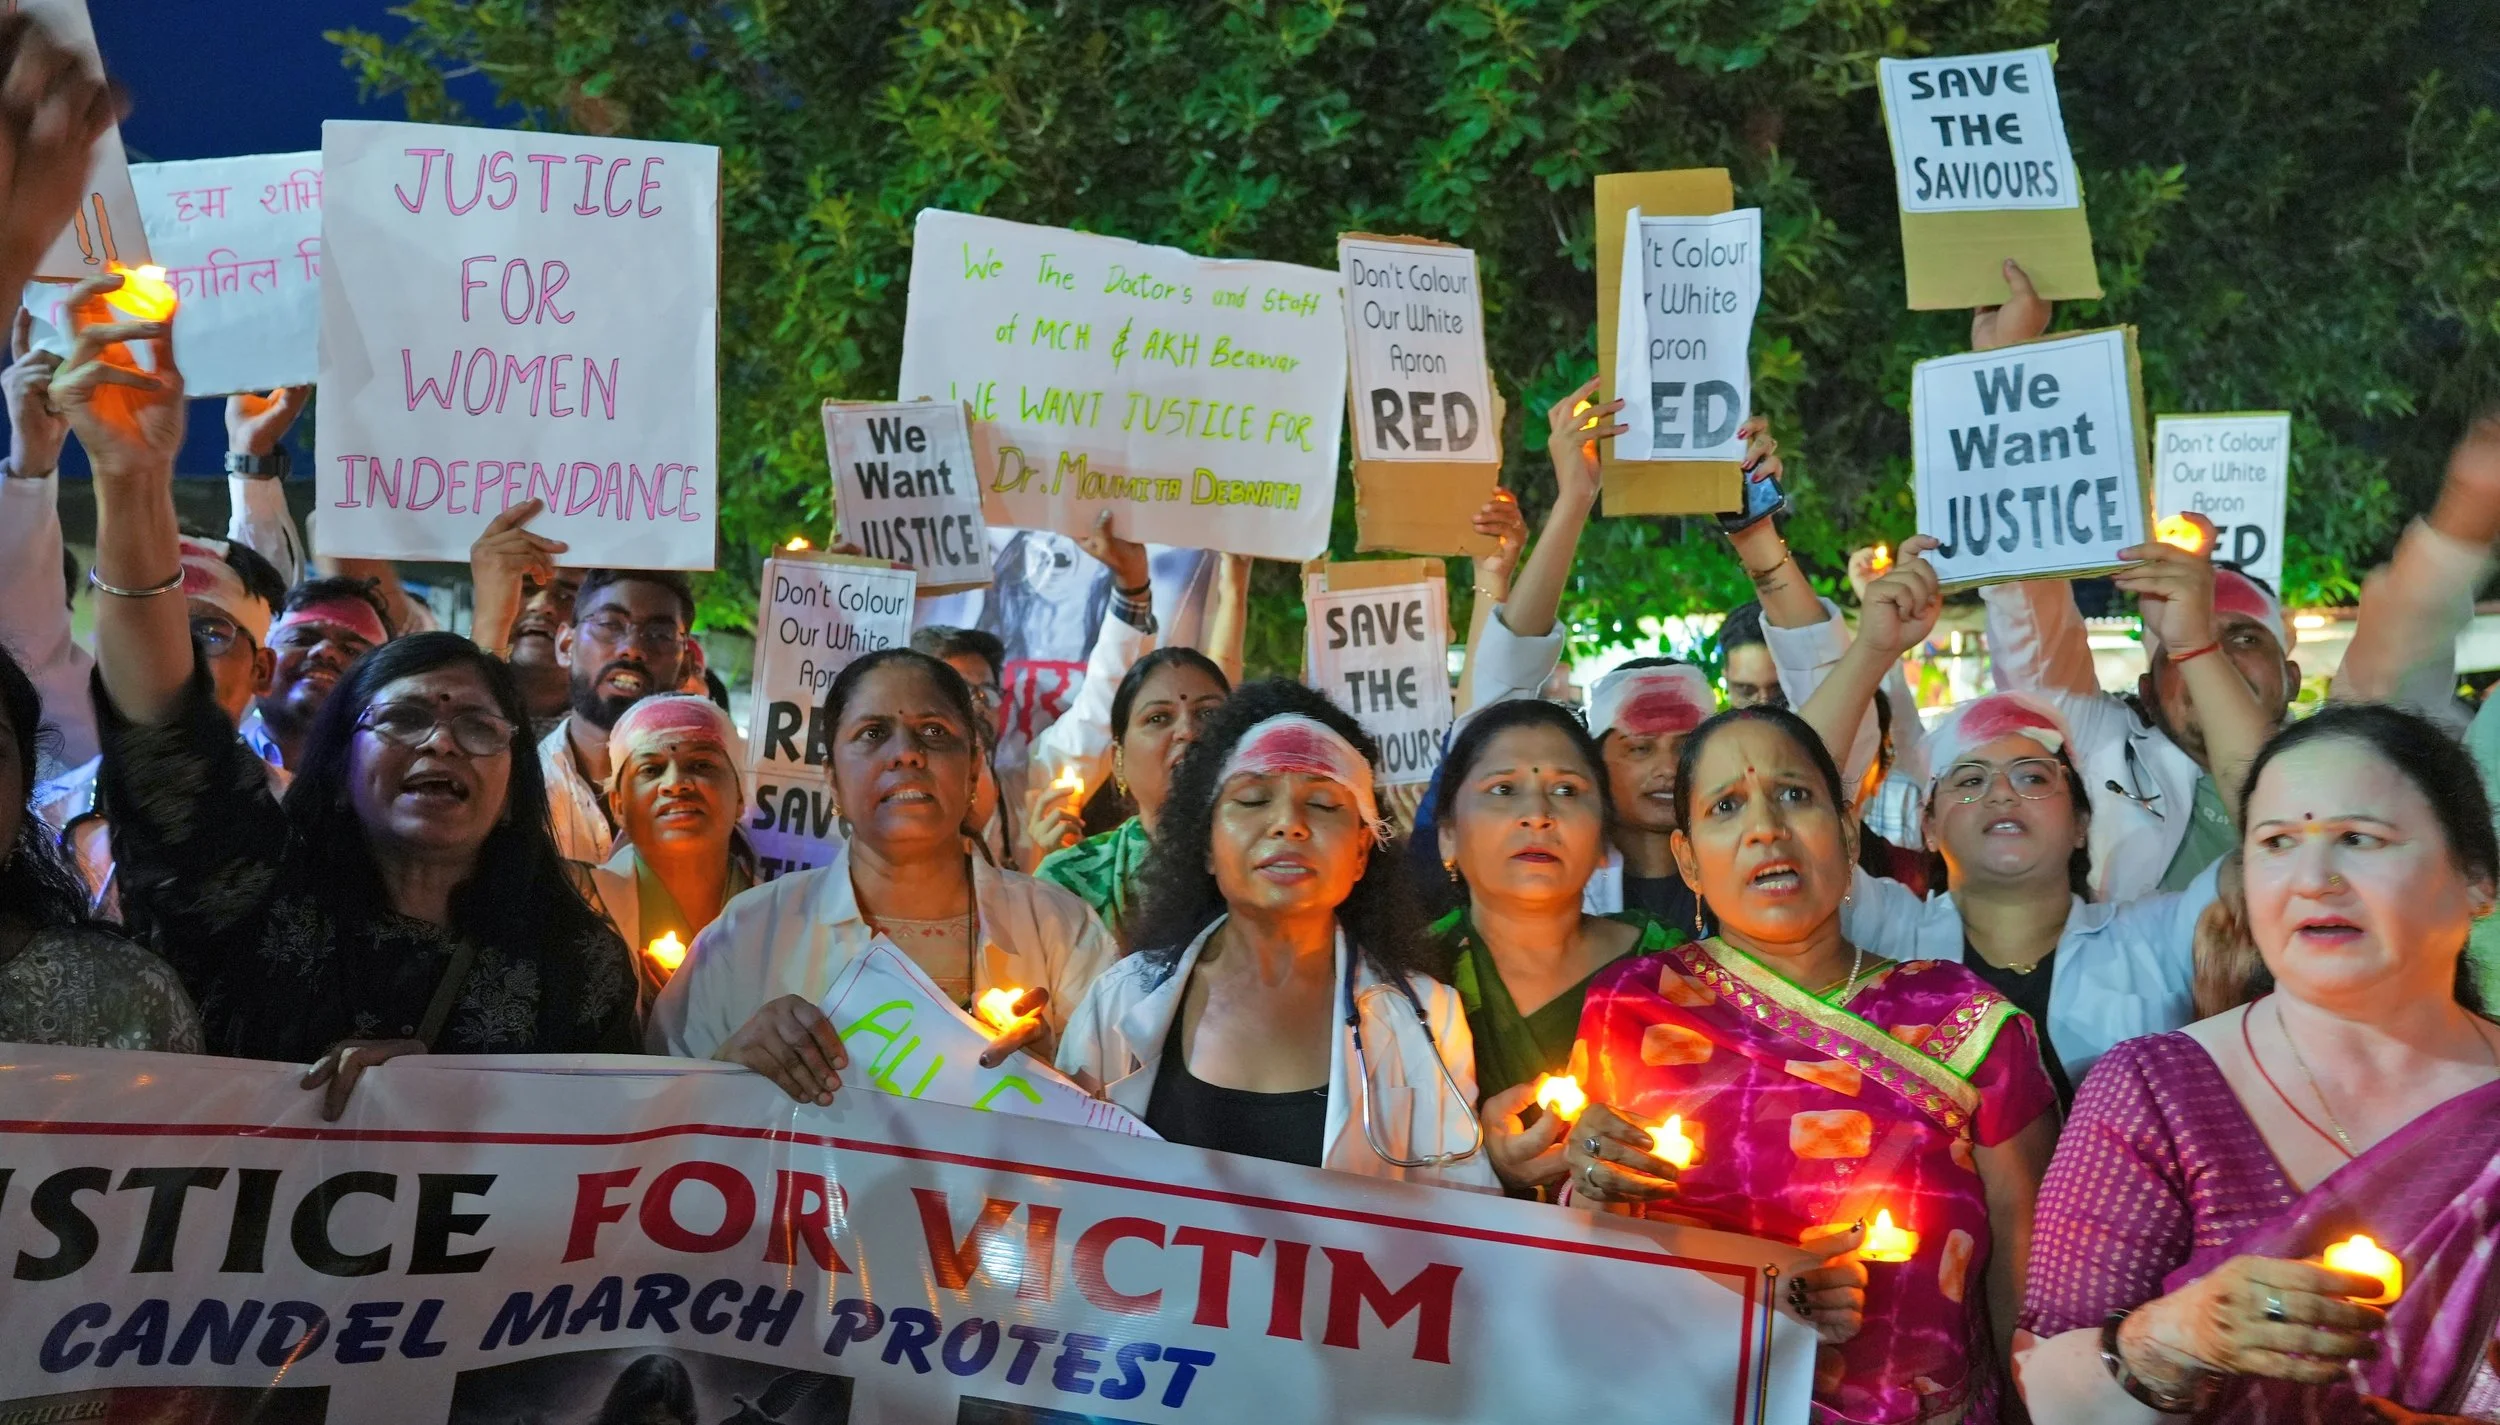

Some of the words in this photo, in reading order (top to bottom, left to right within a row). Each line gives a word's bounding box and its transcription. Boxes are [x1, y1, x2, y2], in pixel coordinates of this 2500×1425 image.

[1908, 63, 2029, 100] SAVE
[1931, 113, 2023, 147] THE
[167, 187, 232, 222] हम
[394, 148, 665, 219] JUSTICE
[1353, 259, 1403, 289] Don't
[1409, 265, 1467, 294] Colour
[1672, 238, 1748, 268] Colour
[461, 255, 575, 325] FOR
[963, 241, 1004, 280] We
[1038, 253, 1075, 290] The
[1104, 265, 1193, 304] Doctor's
[1212, 286, 1249, 309] and
[1262, 288, 1321, 317] Staff
[1661, 283, 1737, 315] White
[996, 313, 1018, 344] of
[1032, 317, 1091, 351] MCH
[1142, 328, 1200, 369] AKH
[1364, 300, 1399, 330] Our
[1406, 303, 1463, 334] White
[1390, 344, 1446, 380] Apron
[1650, 338, 1706, 369] pron
[401, 347, 619, 420] WOMEN
[1974, 363, 2060, 416] We
[867, 416, 926, 454] We
[1021, 386, 1104, 427] WANT
[1122, 392, 1255, 441] JUSTICE
[1264, 410, 1313, 452] FOR
[1371, 388, 1478, 452] RED
[1651, 379, 1741, 450] ED
[1948, 412, 2096, 472] Want
[2168, 433, 2213, 453] Don't
[2220, 432, 2276, 452] Colour
[335, 454, 700, 522] INDEPENDANCE
[855, 459, 956, 500] Want
[2173, 461, 2207, 483] Our
[2212, 461, 2267, 483] White
[1938, 476, 2123, 559] JUSTICE
[775, 576, 831, 608] Don't
[839, 584, 905, 615] Colour
[780, 617, 819, 645] Our
[827, 621, 889, 651] White
[1326, 600, 1425, 650] SAVE
[800, 660, 835, 695] Apr
[1344, 666, 1418, 714] THE
[763, 701, 826, 766] RE
[752, 785, 850, 840] SAV
[0, 1166, 498, 1282] STICE
[560, 1160, 854, 1275] FOR
[910, 1186, 1464, 1365] VICTIM
[39, 1298, 447, 1374] CANDEL
[479, 1272, 804, 1350] MARCH
[823, 1297, 1217, 1409] PROTEST
